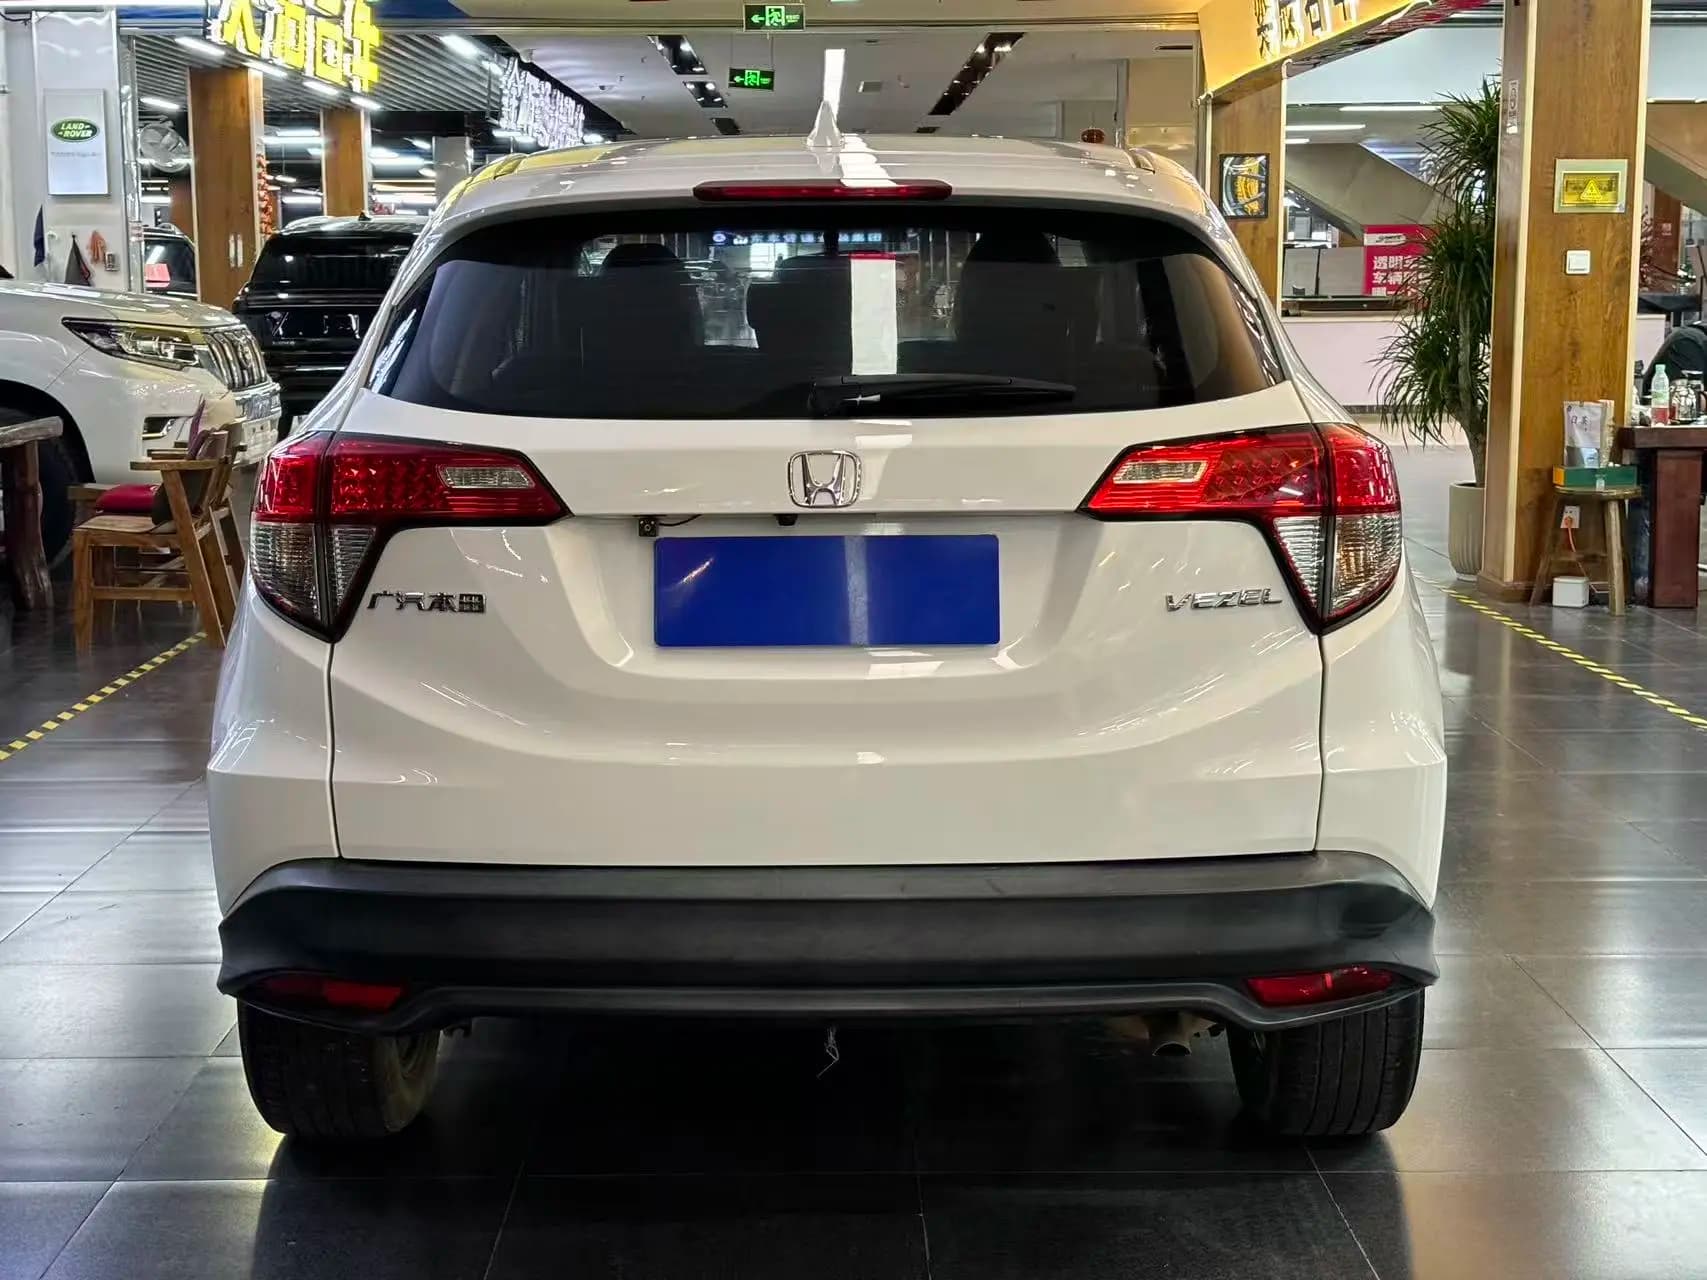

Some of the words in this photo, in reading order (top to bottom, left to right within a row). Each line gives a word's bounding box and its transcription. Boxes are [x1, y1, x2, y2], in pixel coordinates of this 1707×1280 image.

[61, 122, 88, 130] LAND
[61, 130, 93, 138] ROVER
[367, 590, 487, 614] 广汽本田
[1165, 588, 1283, 612] VEZEL
